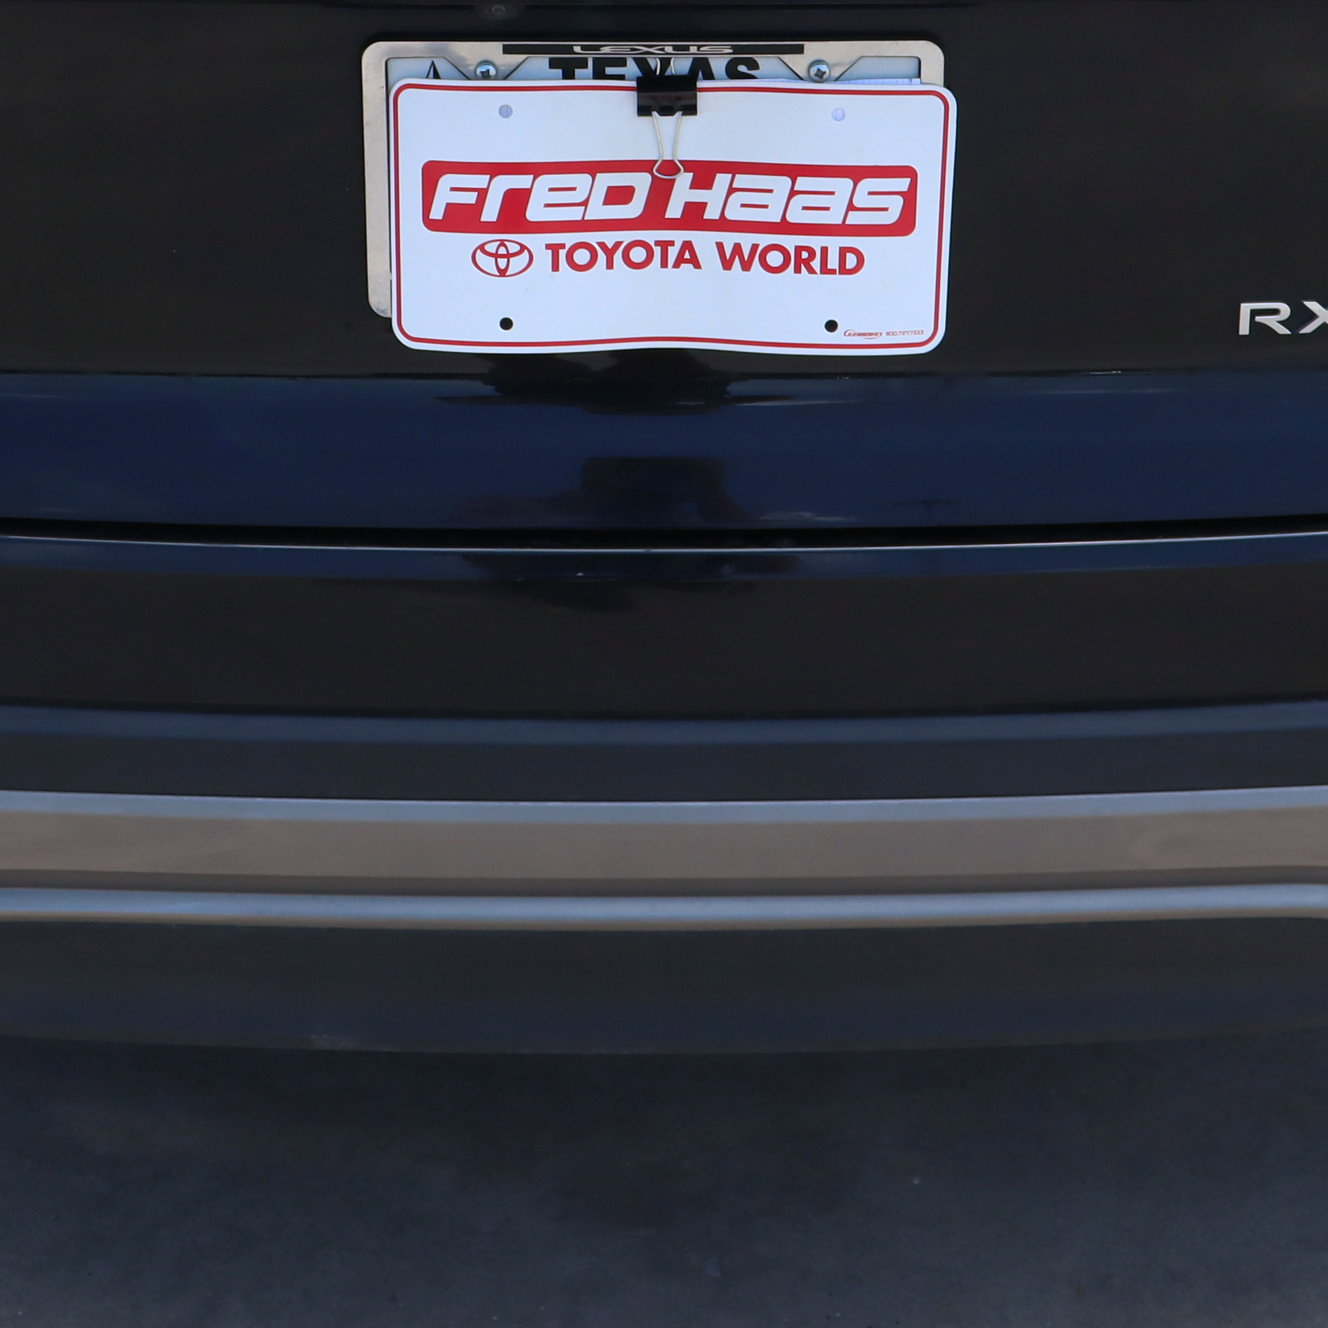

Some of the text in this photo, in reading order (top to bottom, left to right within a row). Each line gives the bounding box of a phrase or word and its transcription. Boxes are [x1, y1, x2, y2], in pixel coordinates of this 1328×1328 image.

[572, 45, 734, 54] LEXUS
[544, 239, 865, 276] TOYOTA WORLD
